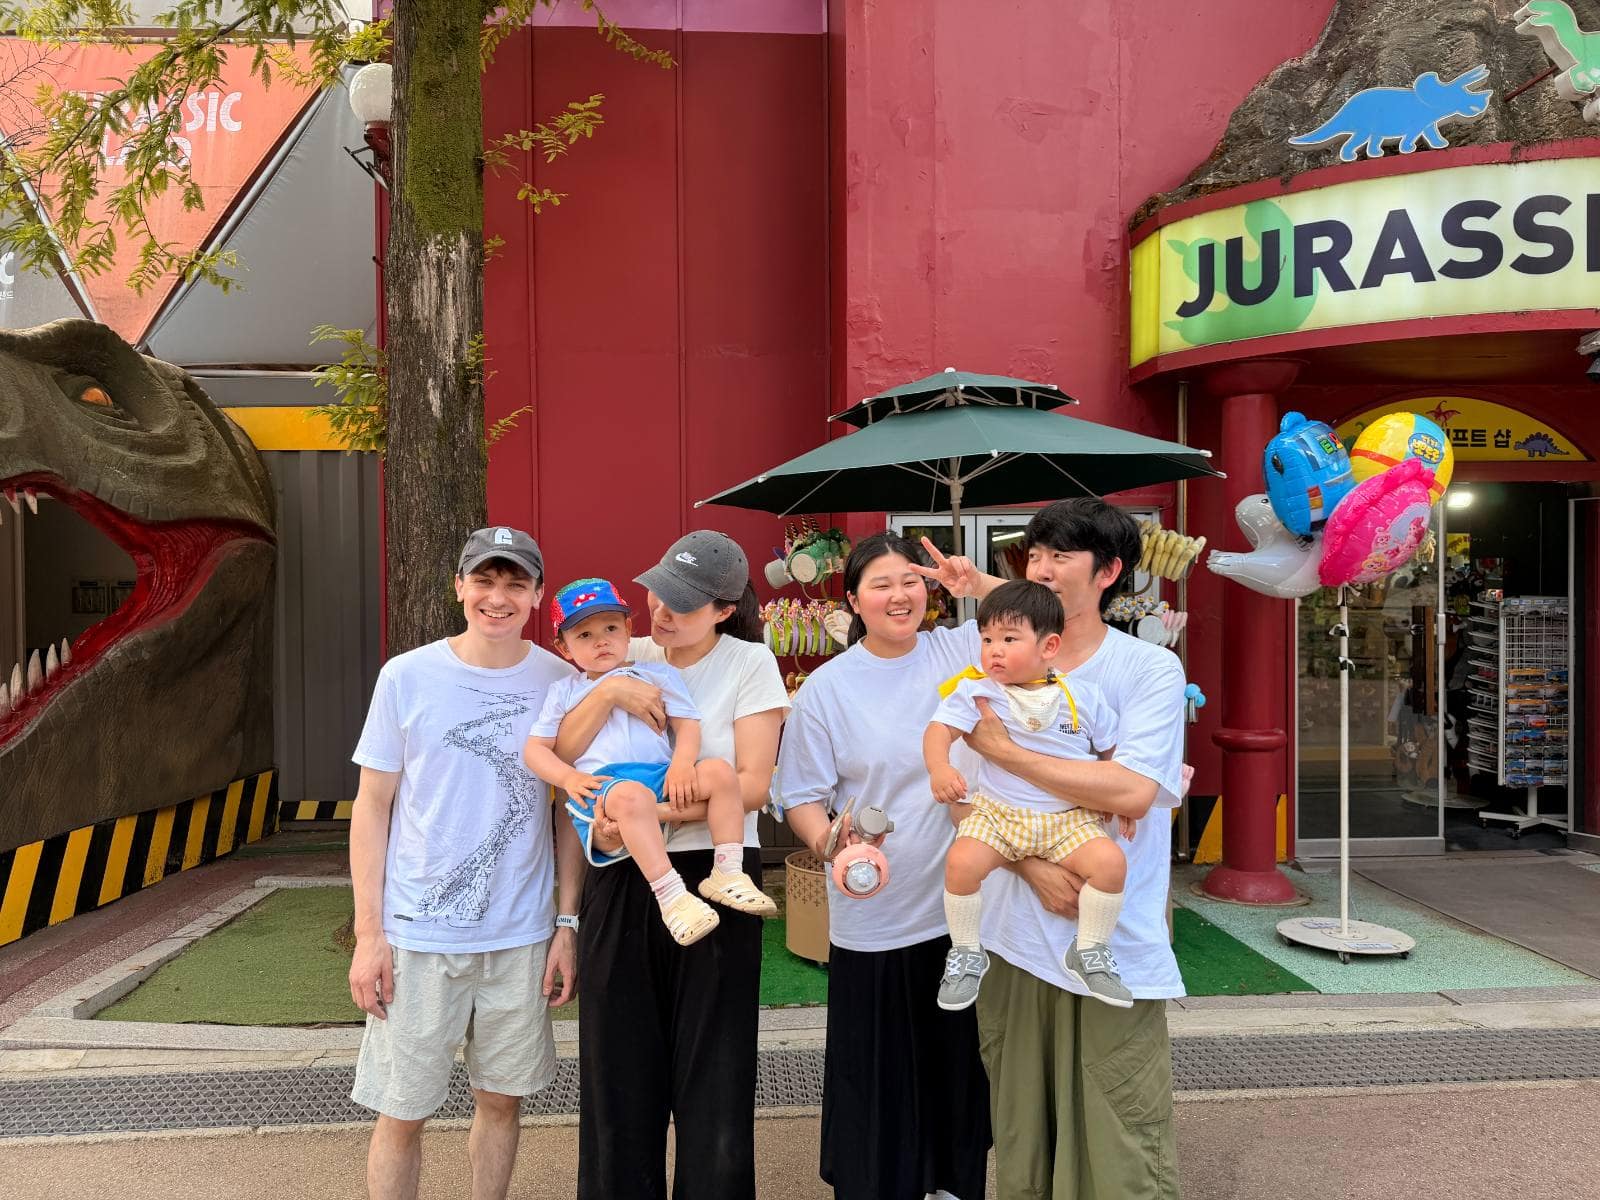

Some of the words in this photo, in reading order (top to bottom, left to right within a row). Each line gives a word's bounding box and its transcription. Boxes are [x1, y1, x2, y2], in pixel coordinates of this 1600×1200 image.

[1176, 193, 1600, 318] JURASSI
[1493, 428, 1512, 448] 샵
[965, 953, 983, 973] N
[1081, 951, 1104, 971] N
